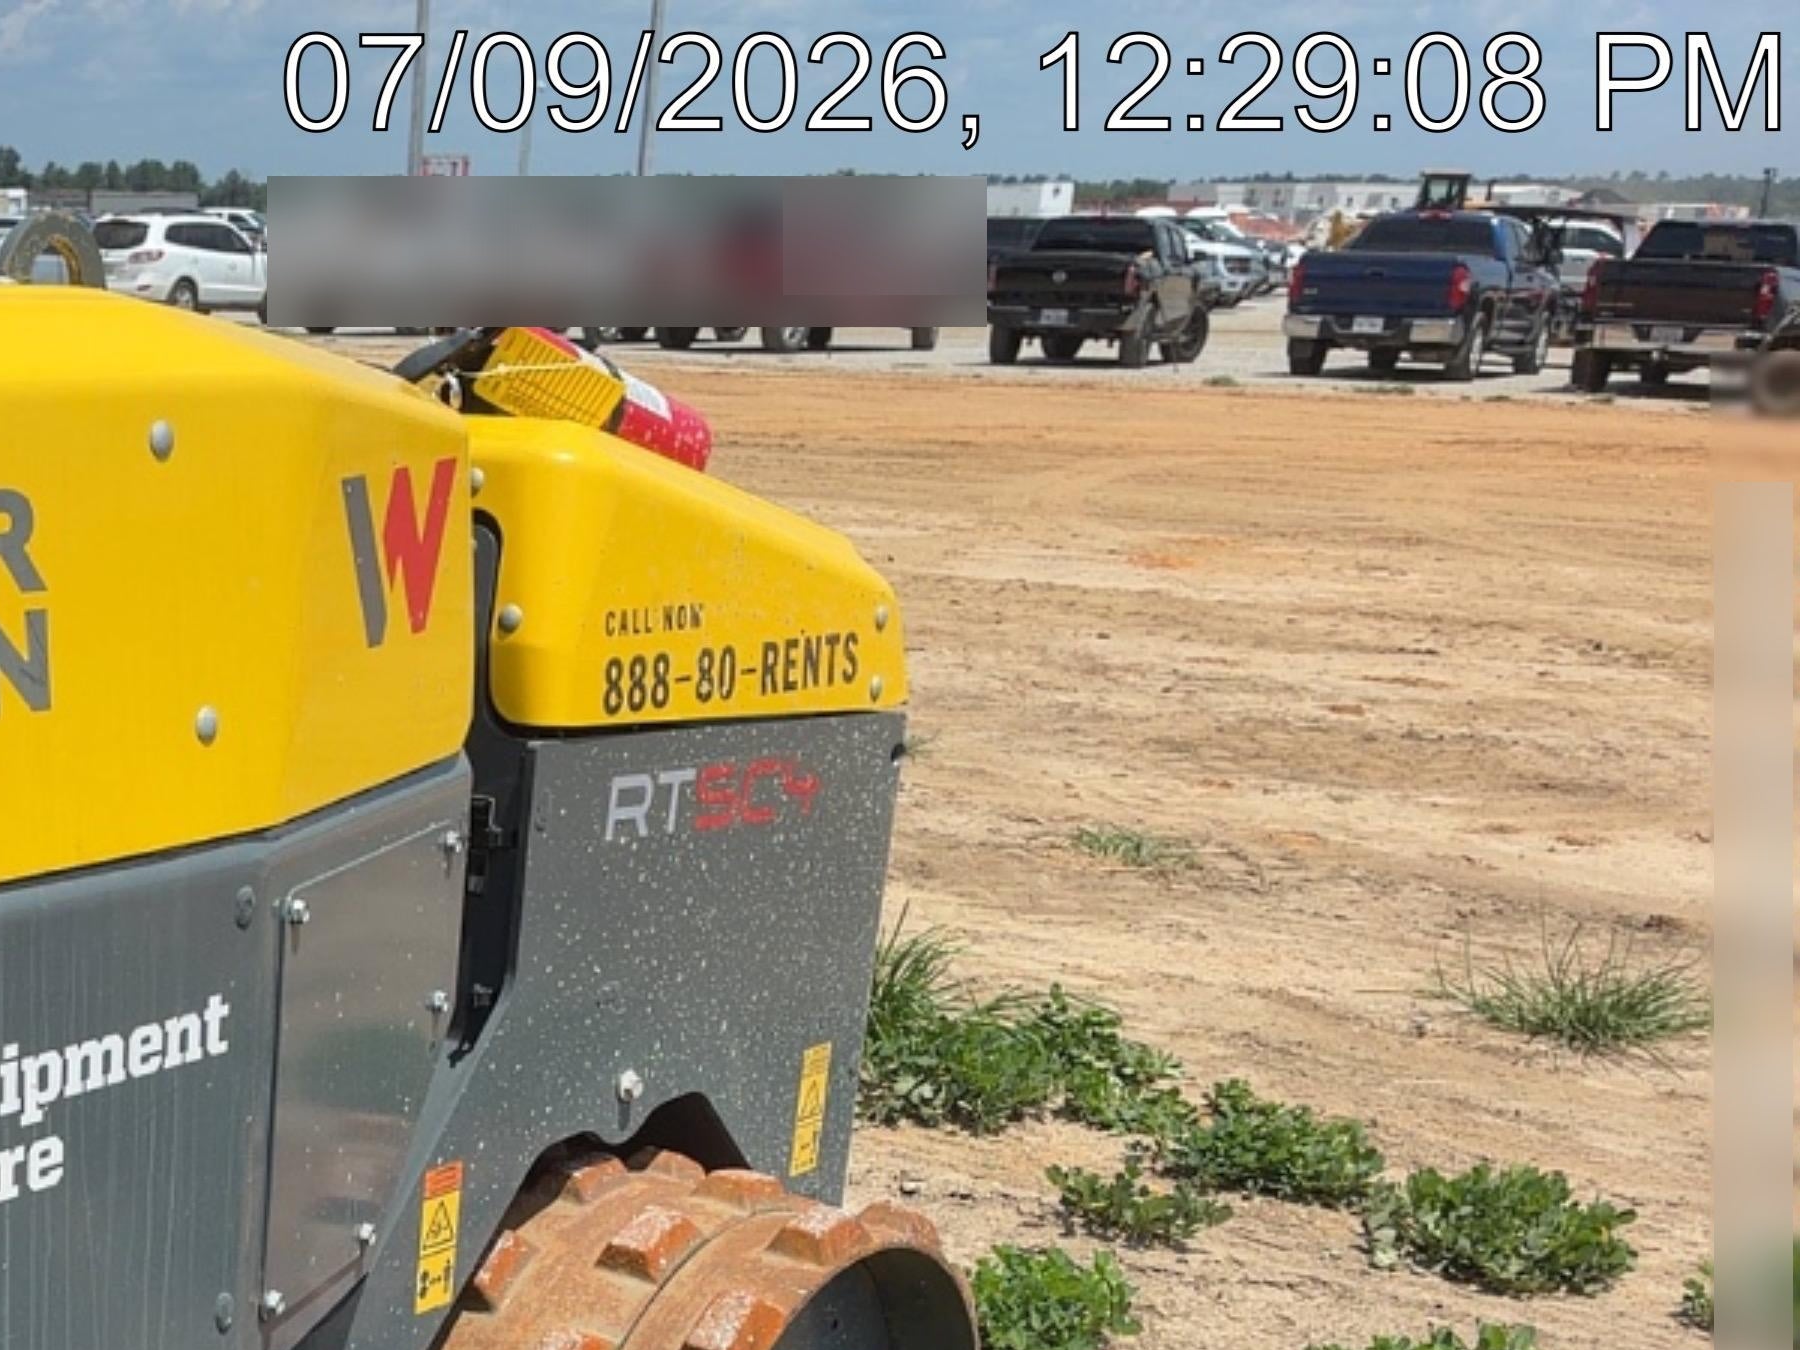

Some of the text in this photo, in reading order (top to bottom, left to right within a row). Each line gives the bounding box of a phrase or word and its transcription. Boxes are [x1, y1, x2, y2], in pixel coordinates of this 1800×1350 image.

[605, 603, 703, 636] CALL NOW
[602, 631, 859, 716] 888-80-RENTS
